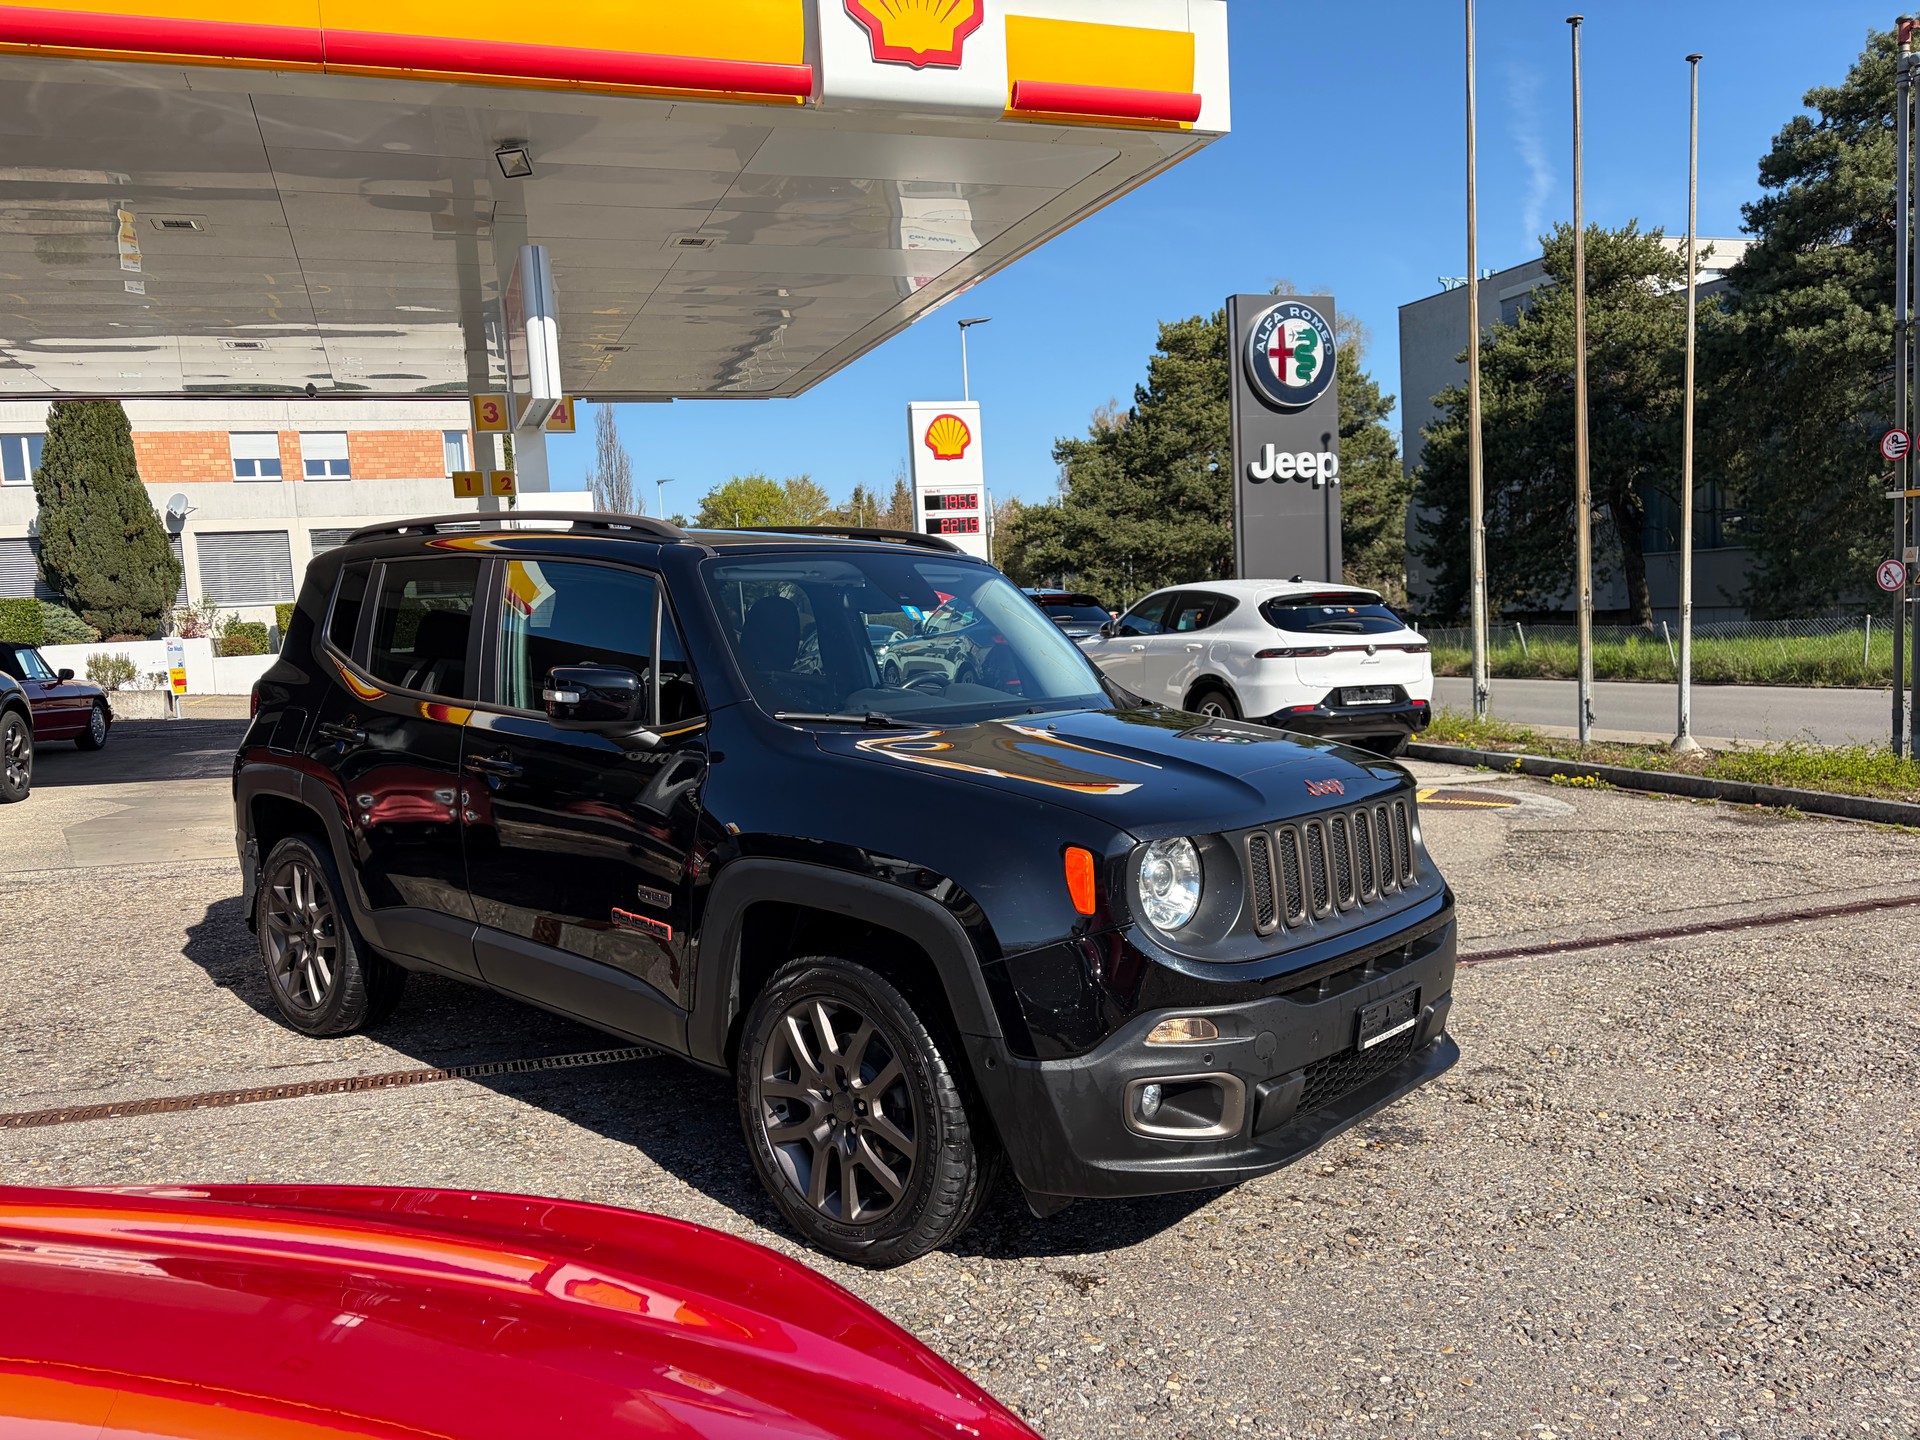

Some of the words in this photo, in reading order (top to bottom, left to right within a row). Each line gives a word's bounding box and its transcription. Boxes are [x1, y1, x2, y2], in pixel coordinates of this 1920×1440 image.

[1255, 312, 1284, 355] ALFA
[1289, 306, 1333, 356] ROMEO
[483, 402, 499, 423] 3
[551, 404, 568, 424] 4
[1251, 443, 1340, 485] Jeep
[464, 478, 471, 491] 1
[500, 477, 512, 491] 2
[943, 493, 978, 510] 195.9
[940, 517, 979, 534] 227.9
[1304, 778, 1345, 797] Jeep
